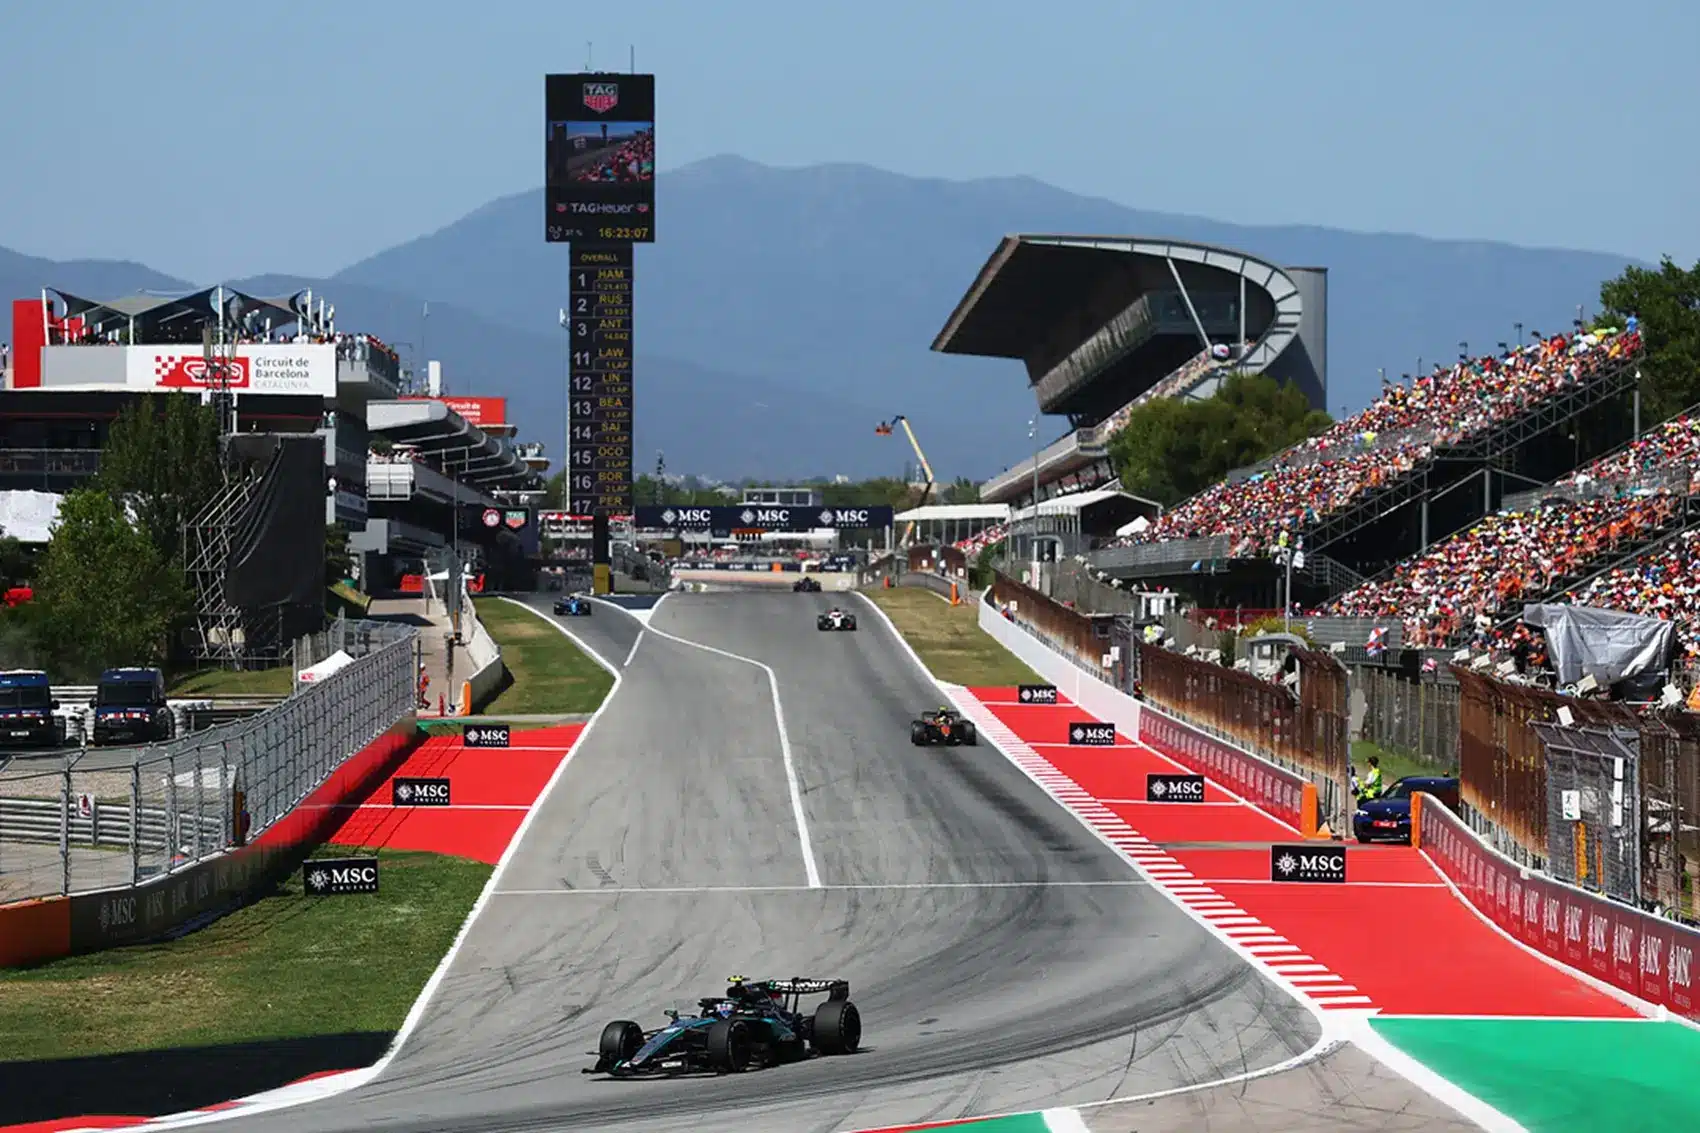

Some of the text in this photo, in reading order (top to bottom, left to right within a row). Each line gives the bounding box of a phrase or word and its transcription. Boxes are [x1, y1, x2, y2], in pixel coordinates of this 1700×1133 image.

[587, 85, 615, 95] TAG
[599, 227, 648, 238] 16:23:07
[580, 253, 618, 262] OVERALL
[578, 269, 625, 287] 1 HAM
[577, 294, 623, 312] 2 RUS
[578, 319, 622, 336] 3 ANT
[255, 356, 309, 367] Circuit de
[574, 347, 624, 365] 11 LAW
[255, 368, 309, 378] Barcelona
[255, 380, 310, 389] CATALUNYA
[573, 373, 620, 390] 12 LIN
[573, 398, 623, 415] 13 BEA
[573, 422, 620, 439] 14 SAI
[573, 446, 624, 464] 15 OCO
[573, 471, 623, 489] 16 BOR
[573, 496, 622, 513] 17 PER
[678, 509, 711, 521] MSC
[757, 509, 789, 521] MSC
[835, 510, 868, 522] MSC
[1033, 689, 1056, 698] MSC
[480, 730, 508, 741] MSC
[1086, 728, 1113, 739] MSC
[414, 784, 448, 797] MSC
[1168, 781, 1202, 794] MSC
[1299, 855, 1343, 871] MSC
[331, 867, 376, 884] MSC
[111, 897, 136, 925] MSC
[1646, 935, 1662, 976] MSC
[1675, 945, 1693, 988] MSC
